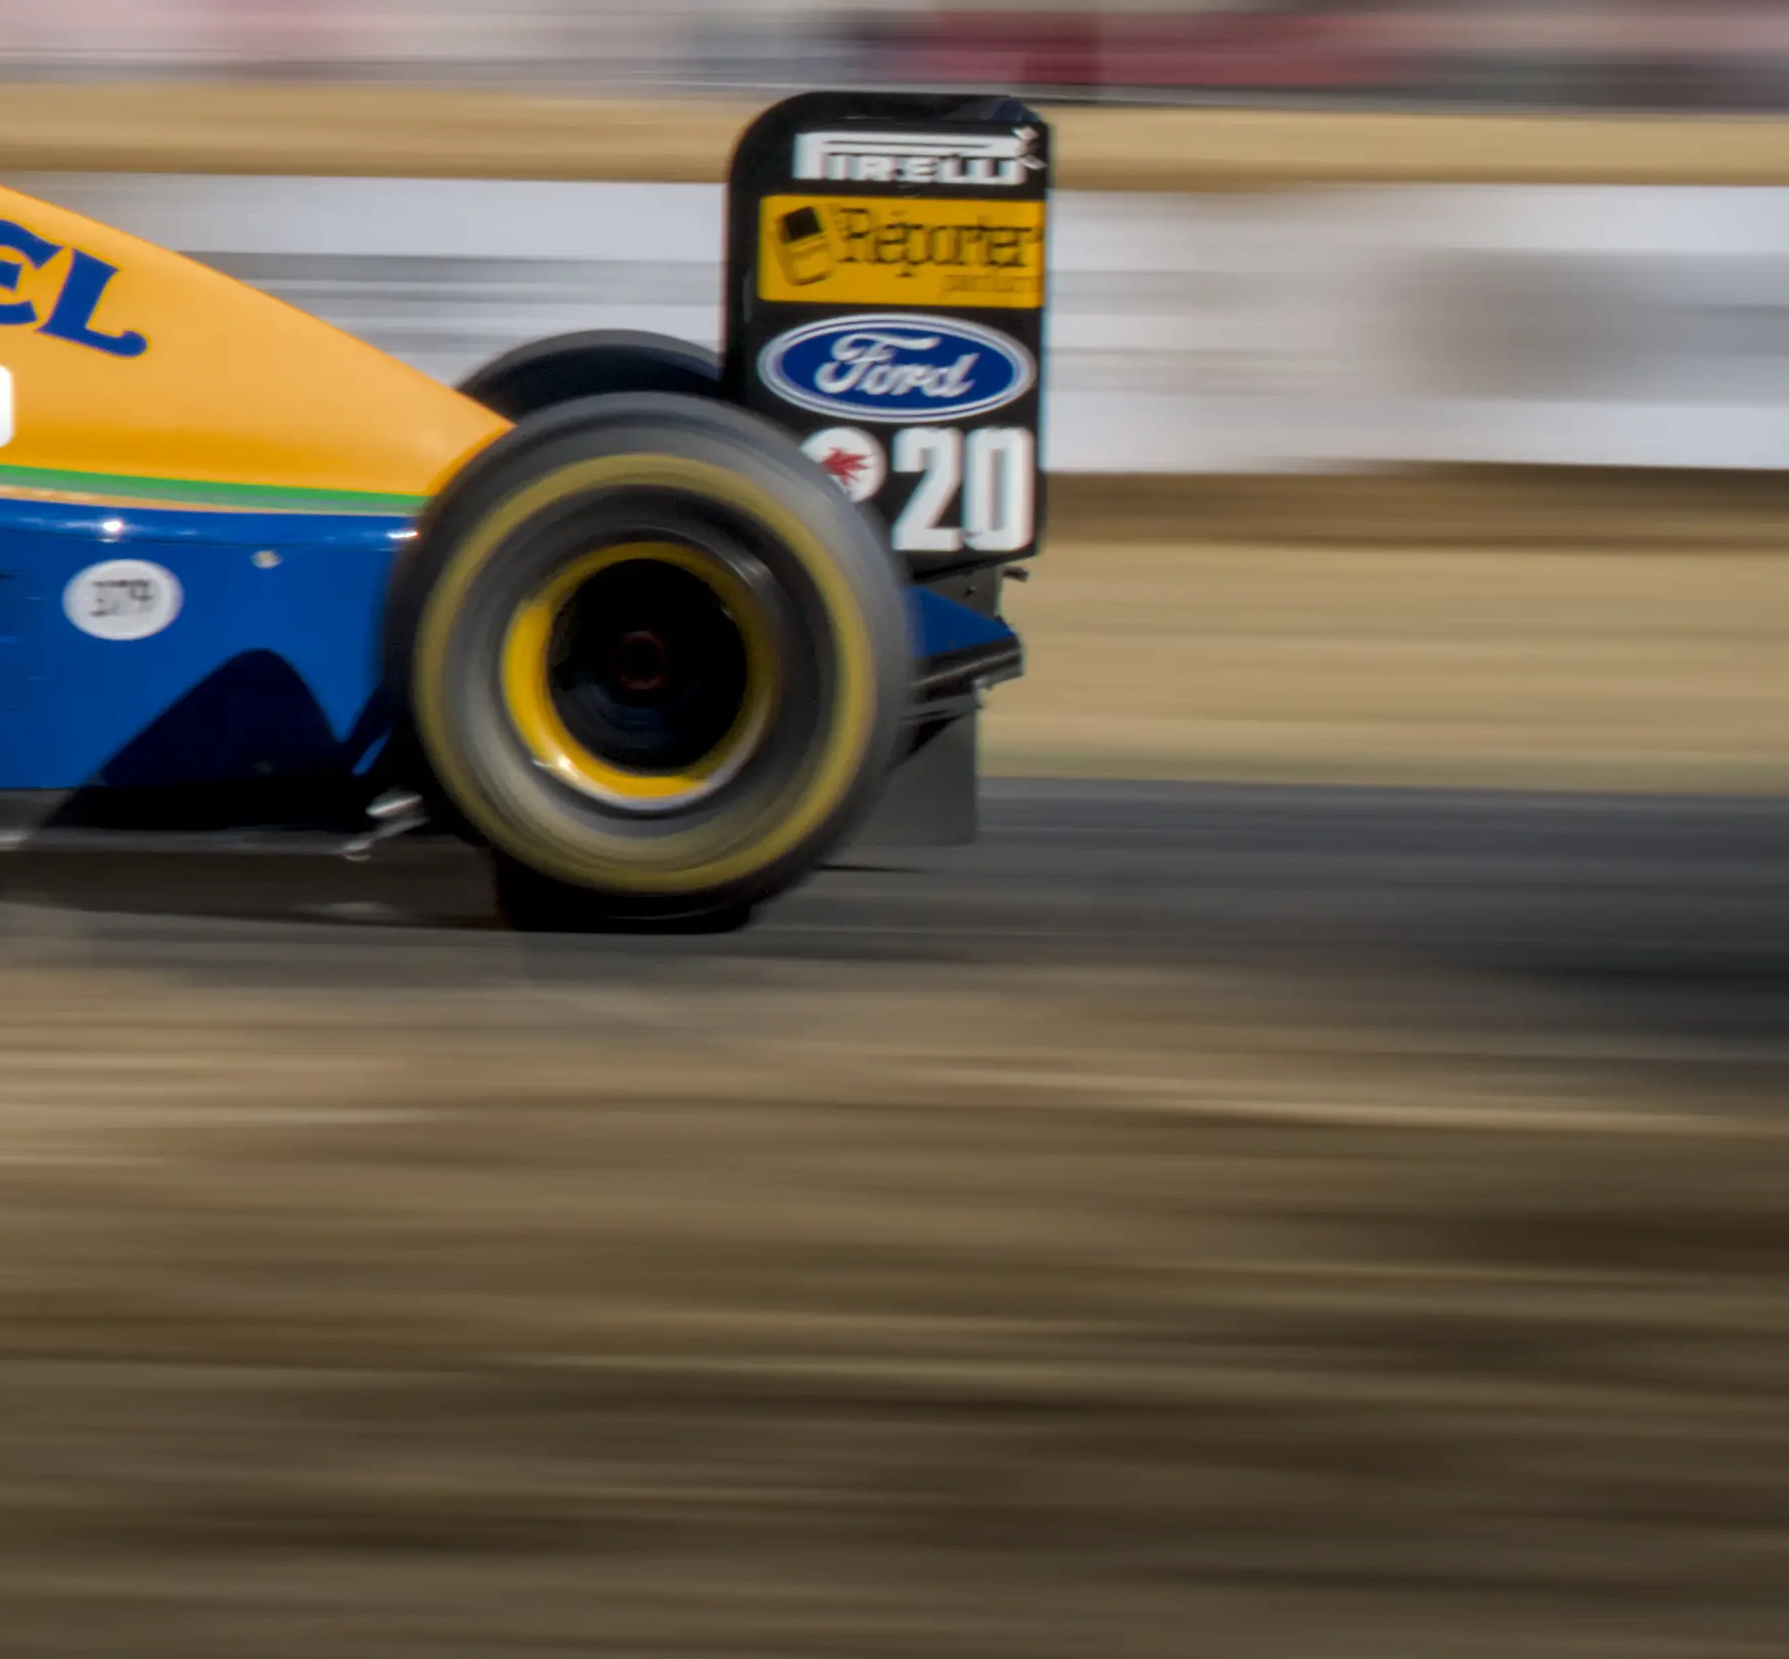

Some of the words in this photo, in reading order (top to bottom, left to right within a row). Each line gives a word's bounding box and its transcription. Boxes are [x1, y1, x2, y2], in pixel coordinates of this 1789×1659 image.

[792, 132, 1026, 185] PIRELLI
[814, 332, 983, 398] Ford
[892, 426, 1035, 552] 20
